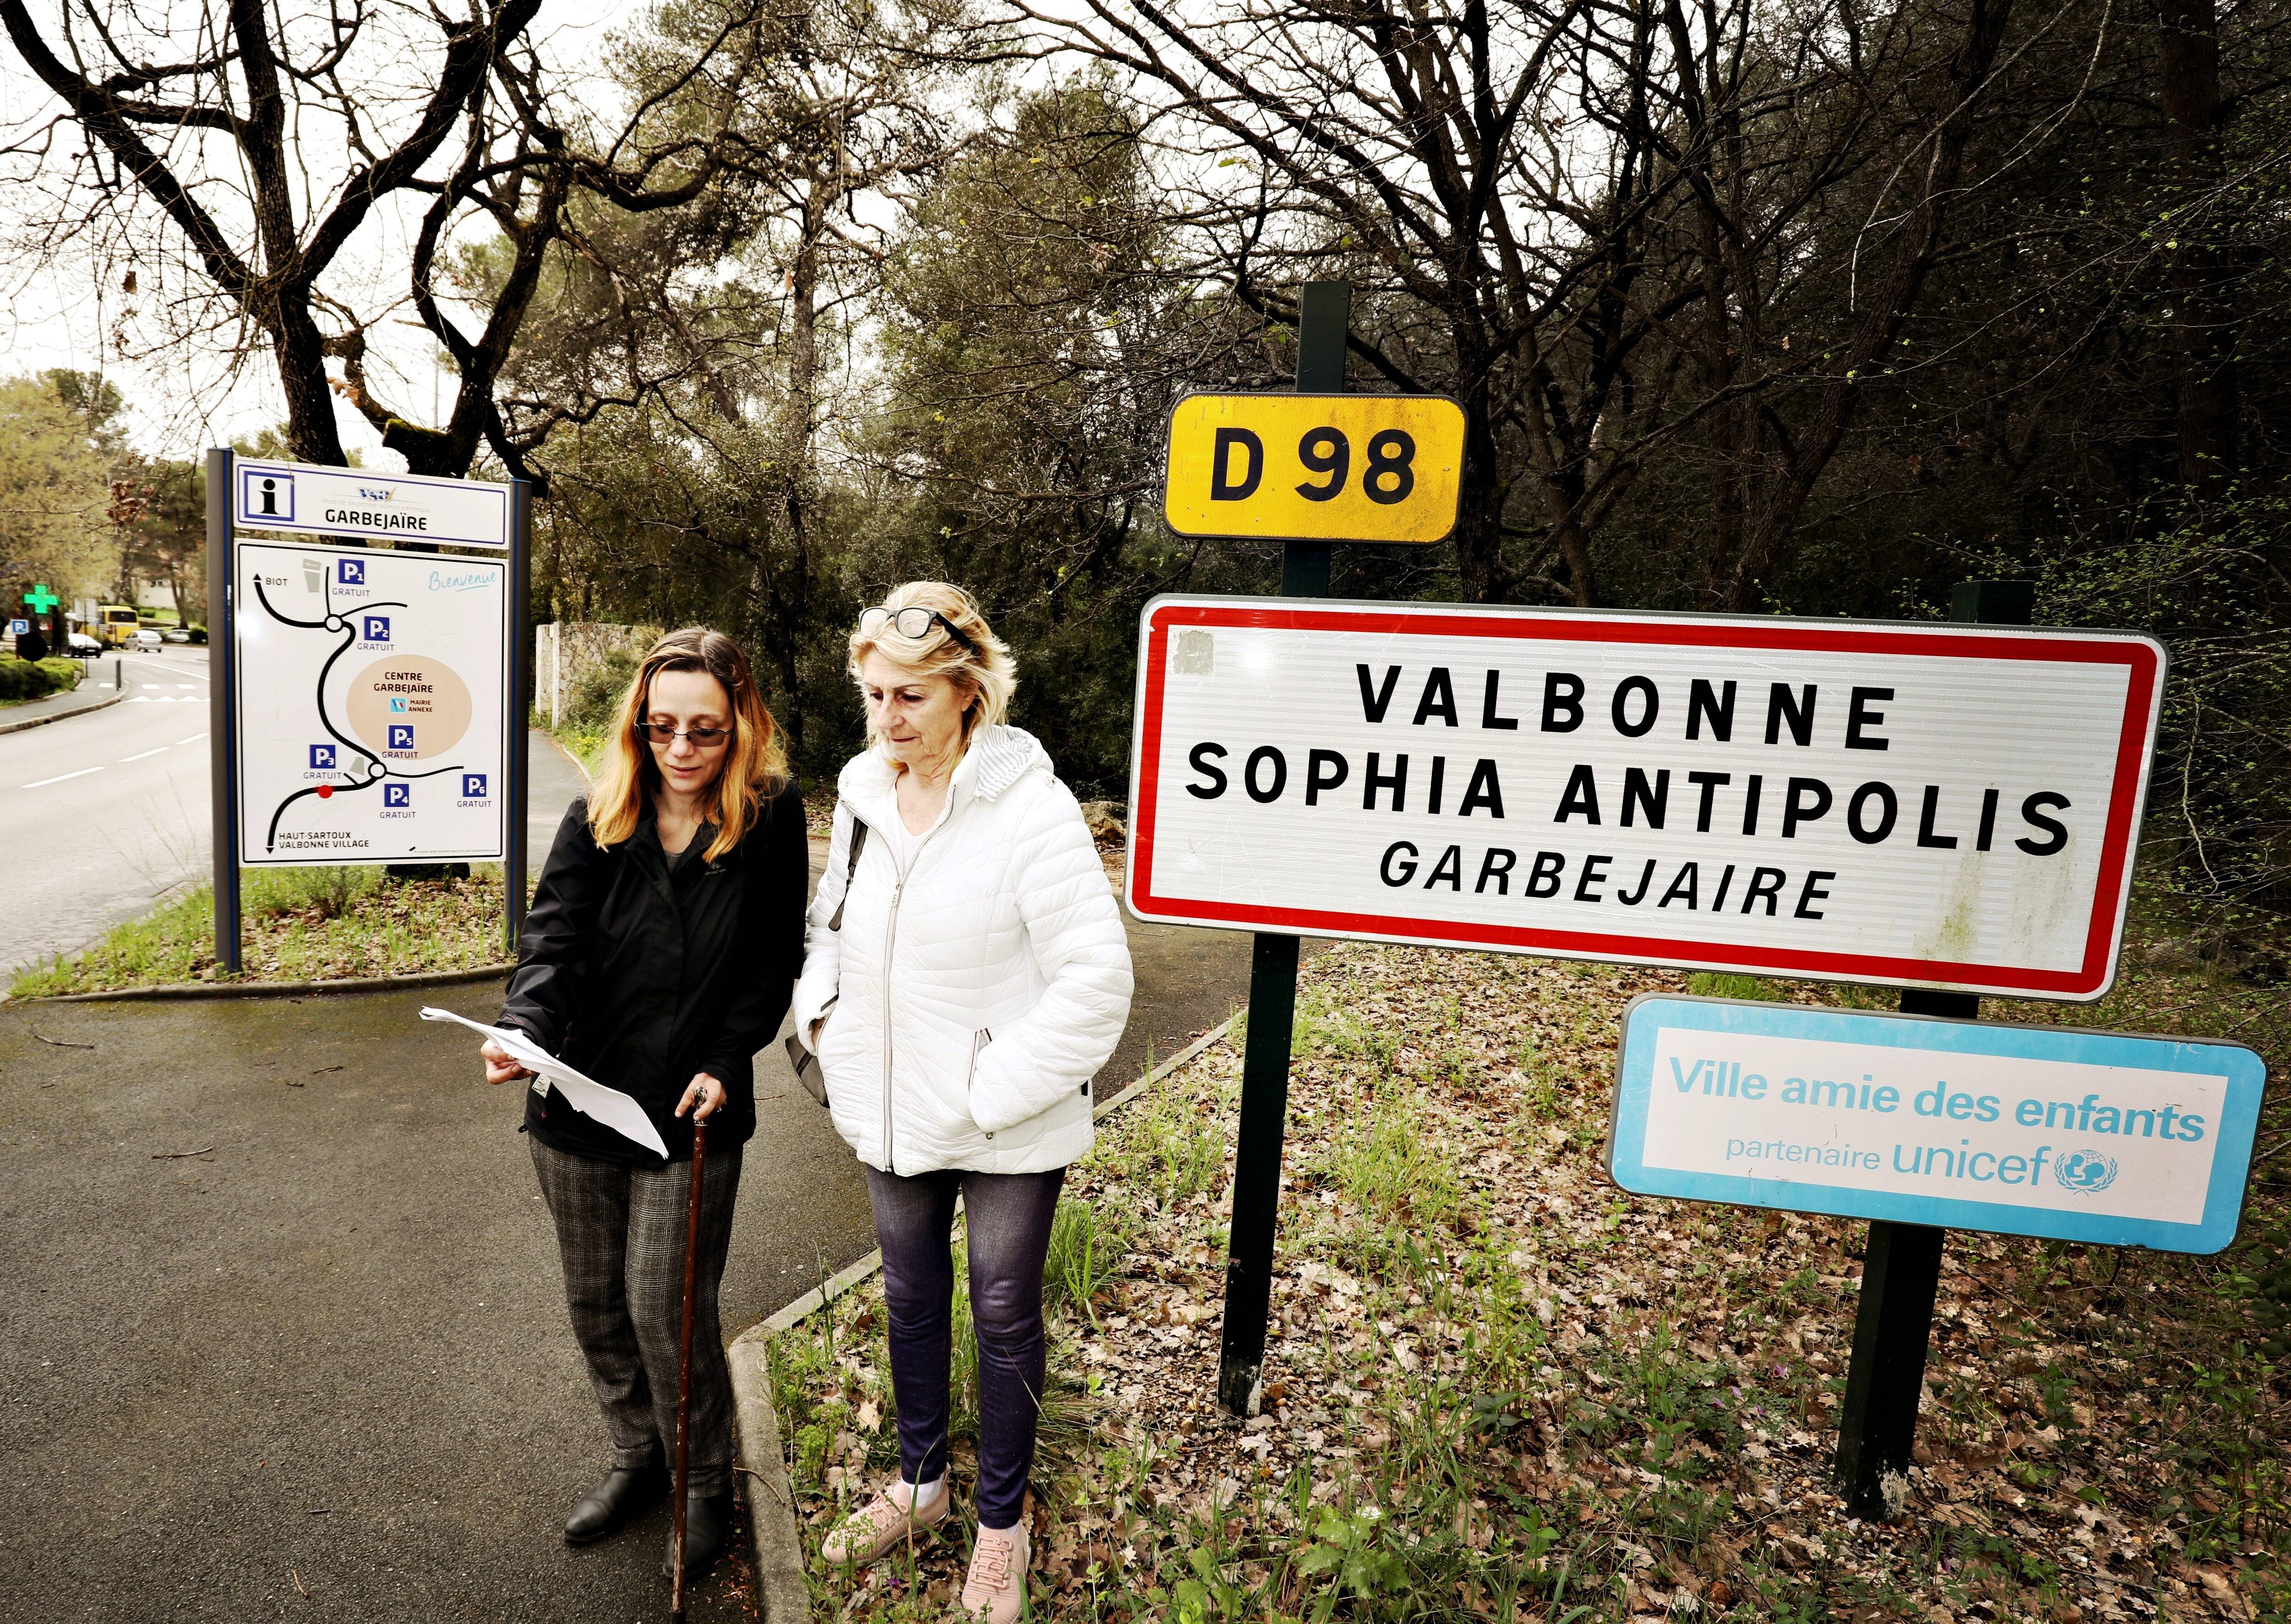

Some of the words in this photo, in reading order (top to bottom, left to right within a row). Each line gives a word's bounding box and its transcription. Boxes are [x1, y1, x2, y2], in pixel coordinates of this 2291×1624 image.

[1211, 428, 1263, 501] D
[1295, 427, 1415, 505] 98
[326, 509, 427, 530] GARBEJAÏRE
[265, 577, 288, 586] BIOT
[429, 571, 497, 591] Bienvenue
[332, 587, 370, 597] GRATUIT
[357, 642, 395, 651] GRATUIT
[384, 672, 422, 681] CENTRE
[374, 683, 433, 694] GARBEJAÏRE
[1356, 664, 1895, 751] VALBONNE
[1186, 742, 1505, 819] SOPHIA
[1553, 764, 2072, 856] ANTIPOLIS
[279, 840, 329, 849] VALBONNE
[1380, 841, 1836, 920] GARBEJAIRE
[1670, 1057, 1768, 1100] Ville
[1781, 1074, 1900, 1113] amie
[1914, 1081, 2001, 1122] des
[2015, 1094, 2205, 1142] enfants
[1726, 1139, 1880, 1170] partenaire
[1893, 1138, 2051, 1186] unicef
